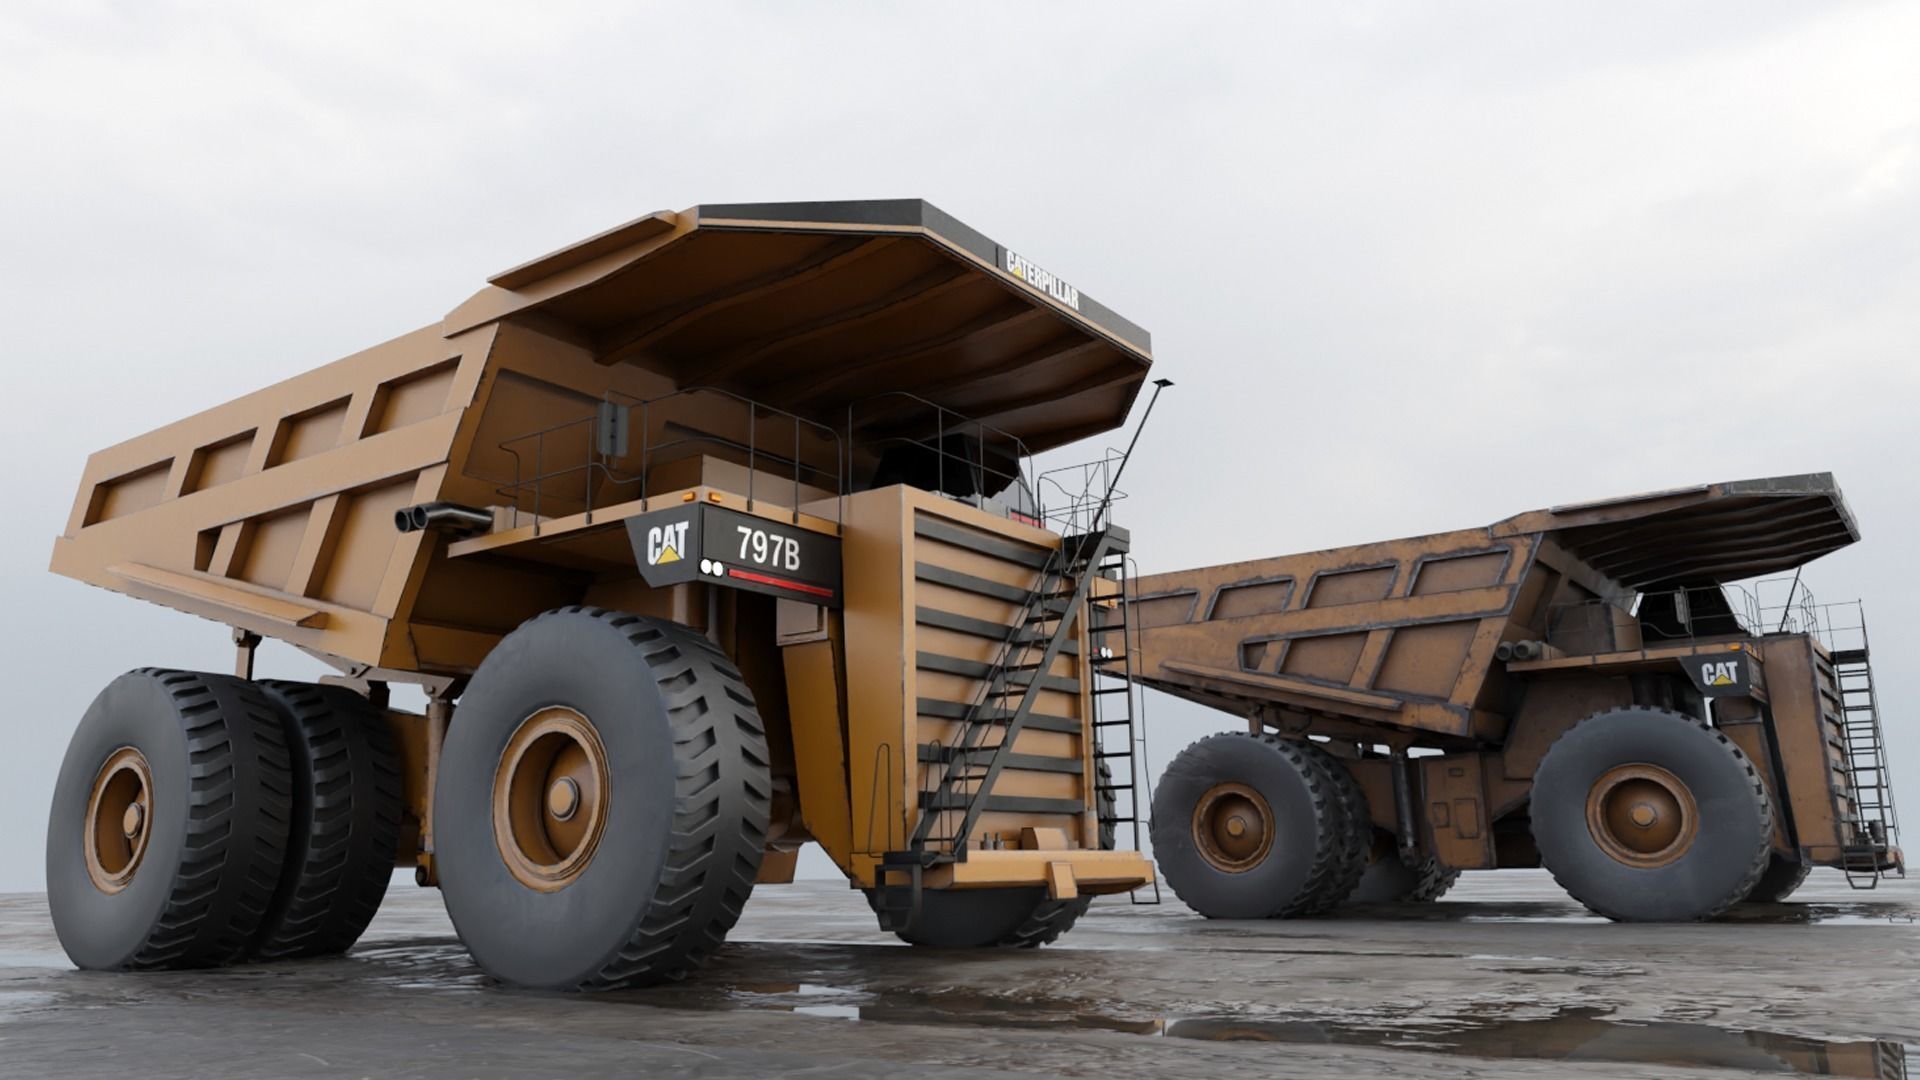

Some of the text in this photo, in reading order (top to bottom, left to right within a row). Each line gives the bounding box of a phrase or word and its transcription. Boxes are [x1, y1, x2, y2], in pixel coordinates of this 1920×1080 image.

[1006, 250, 1079, 310] CATERPILLAR
[647, 521, 689, 565] CAT
[737, 526, 800, 571] 797B
[1701, 661, 1738, 686] CAT
